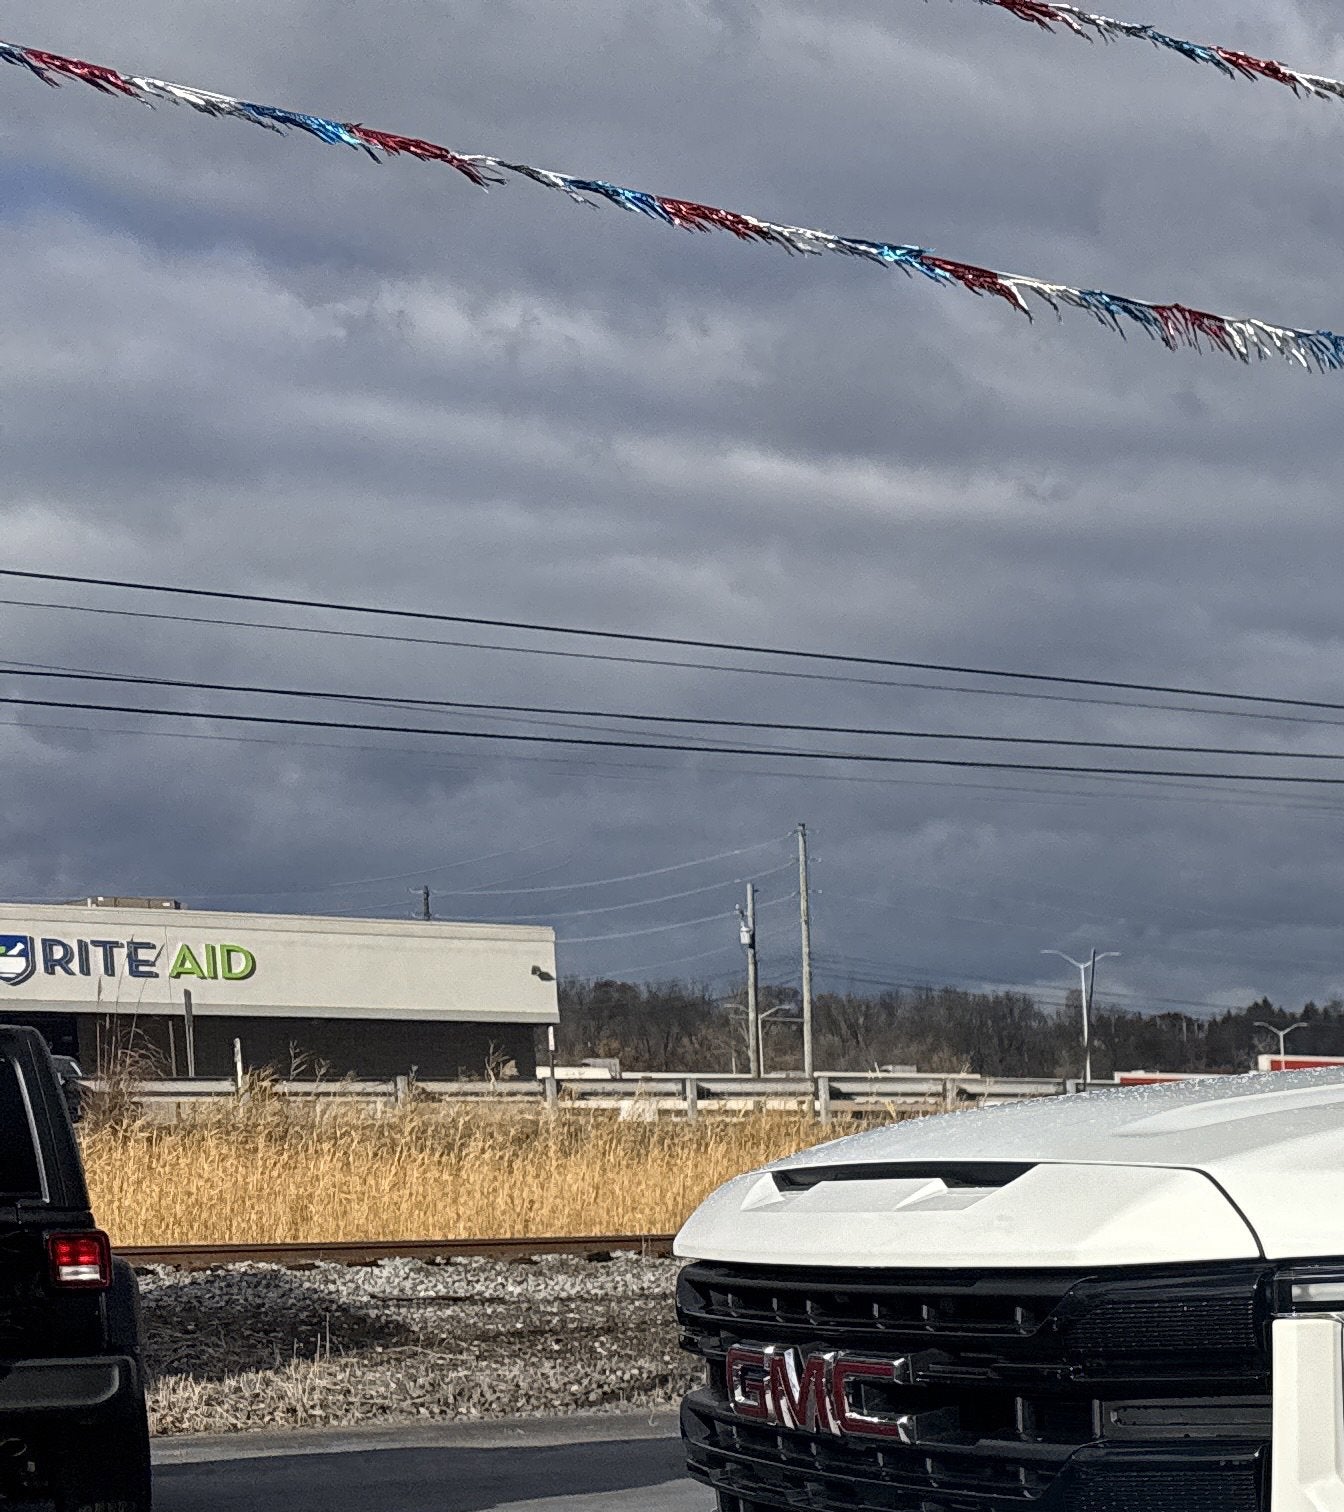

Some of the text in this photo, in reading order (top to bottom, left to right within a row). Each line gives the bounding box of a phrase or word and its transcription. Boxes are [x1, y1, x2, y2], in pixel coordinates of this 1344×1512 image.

[41, 937, 257, 981] RITE AID
[726, 1344, 918, 1445] GMC
